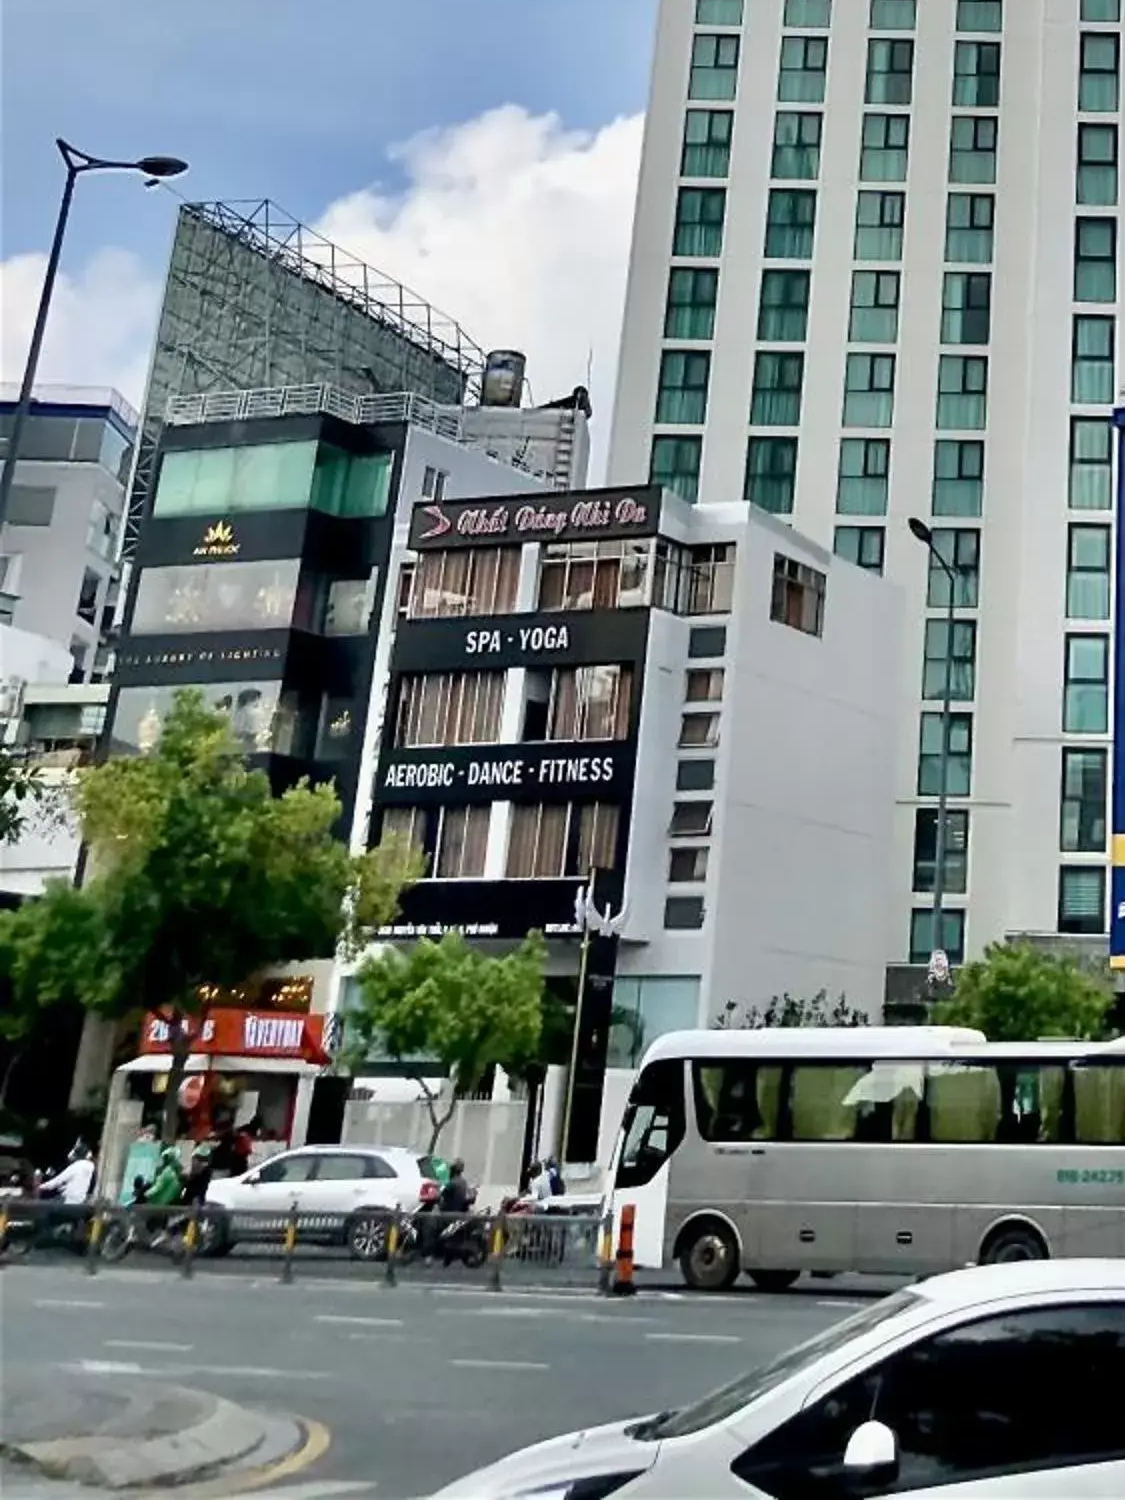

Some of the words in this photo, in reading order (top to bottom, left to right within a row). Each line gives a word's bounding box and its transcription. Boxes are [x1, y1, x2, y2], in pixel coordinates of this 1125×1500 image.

[465, 630, 501, 653] SPA
[519, 625, 569, 651] YOGA
[384, 763, 454, 787] AEROBIC
[467, 760, 523, 785] DANCE
[538, 757, 614, 783] FITNESS
